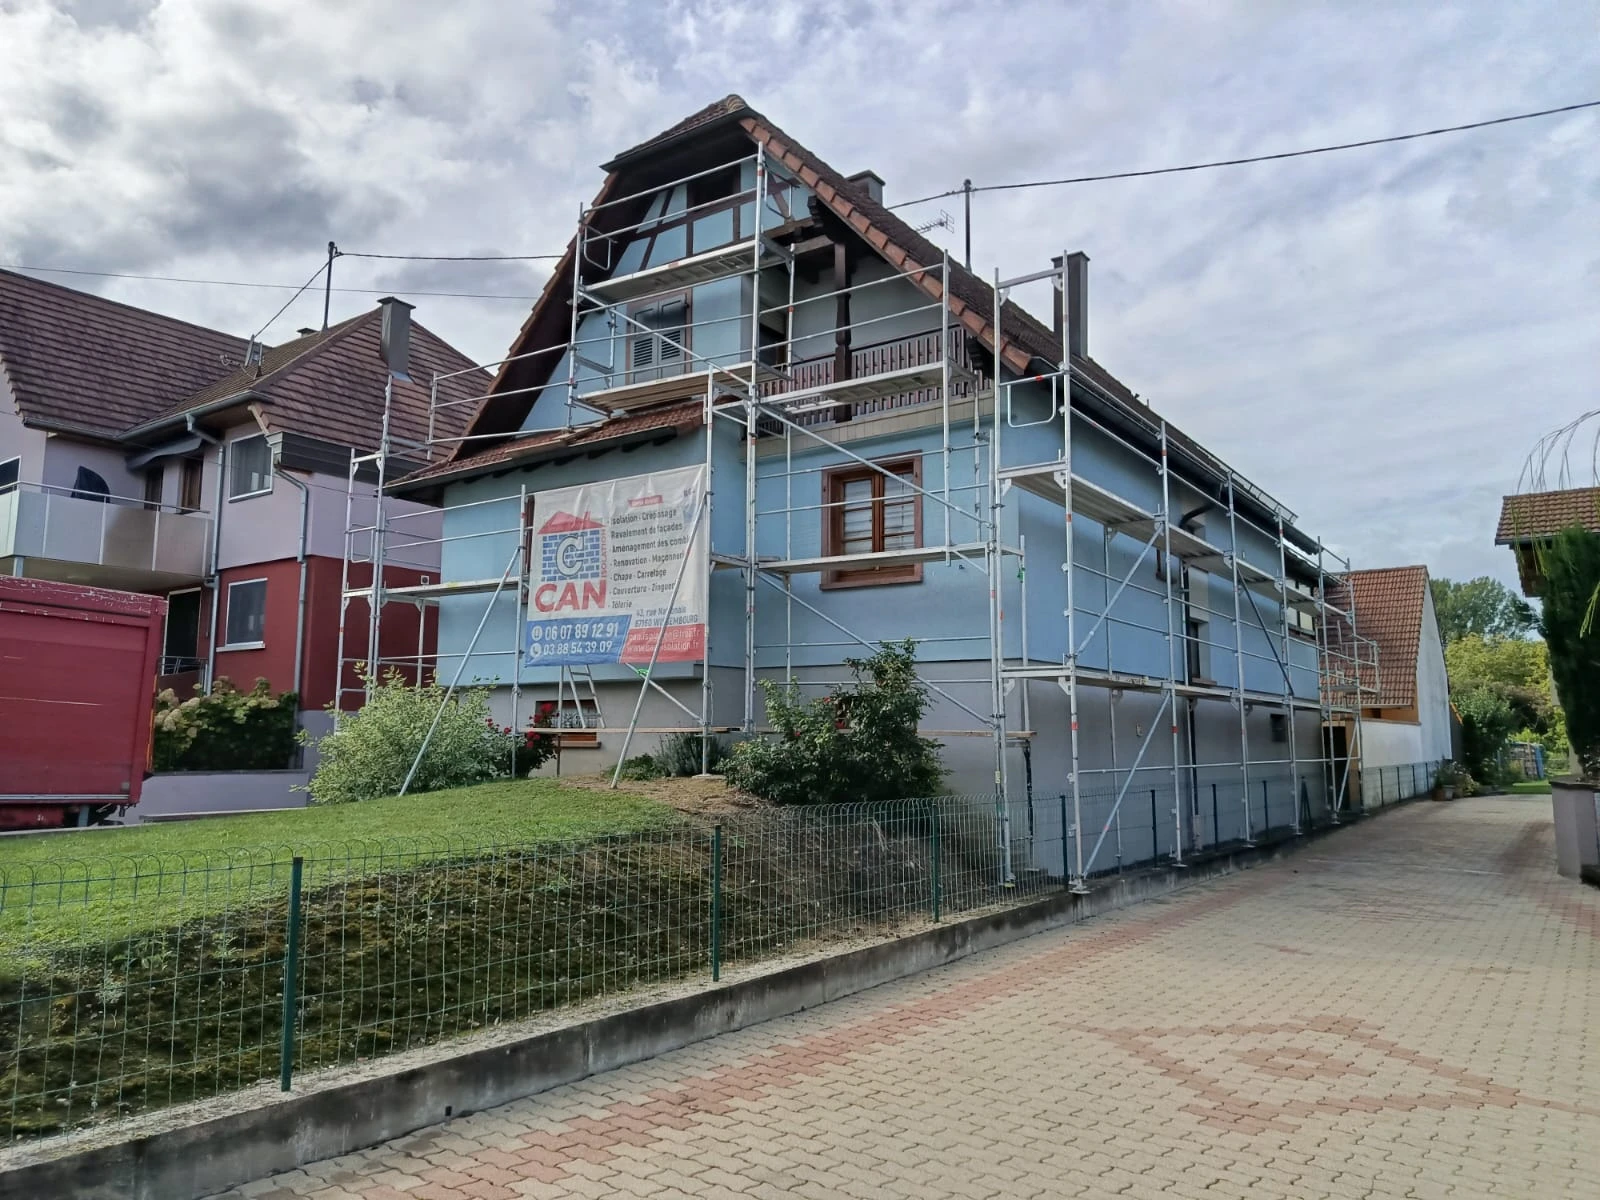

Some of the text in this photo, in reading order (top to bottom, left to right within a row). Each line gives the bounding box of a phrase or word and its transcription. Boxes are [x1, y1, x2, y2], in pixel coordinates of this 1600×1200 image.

[612, 541, 656, 553] Aménagement
[657, 538, 668, 548] des
[613, 573, 632, 582] Chape
[535, 579, 607, 612] CAN
[613, 585, 647, 596] Couverture
[653, 614, 698, 626] WIEMBOURG
[545, 622, 619, 640] 06 07 89 12 91
[543, 640, 613, 656] 03 88 54 39 09
